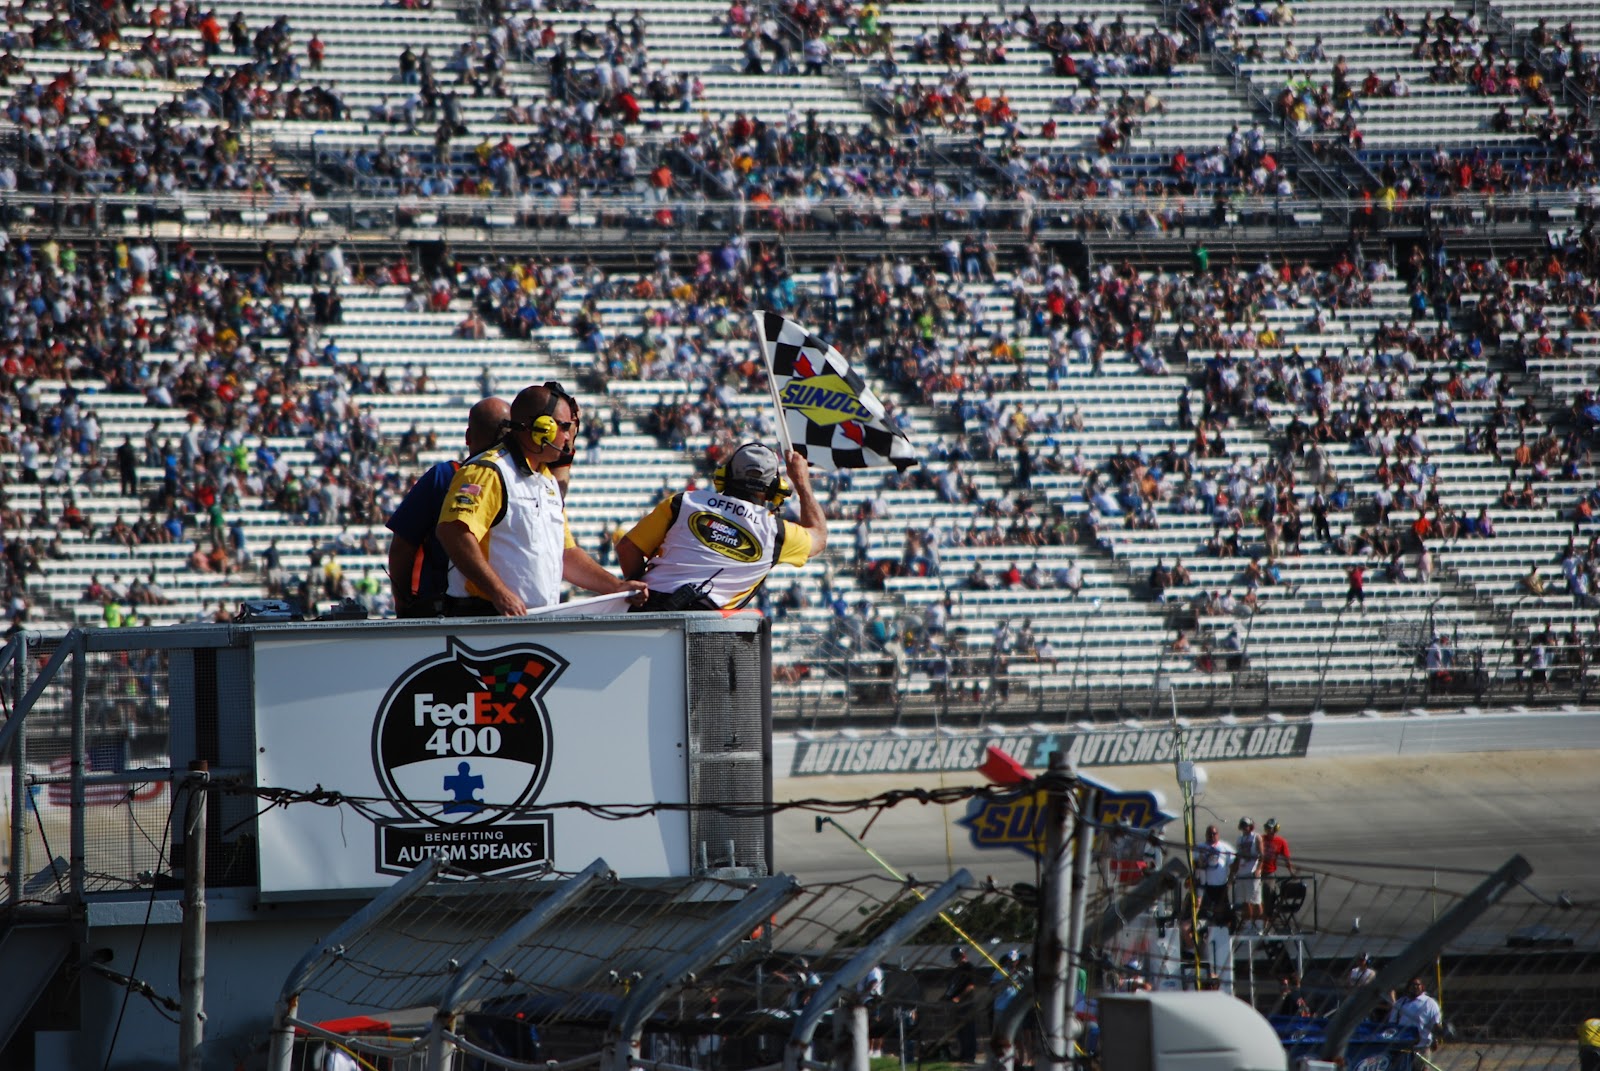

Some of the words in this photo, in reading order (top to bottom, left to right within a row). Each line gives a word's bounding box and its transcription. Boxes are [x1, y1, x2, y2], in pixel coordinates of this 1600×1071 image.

[707, 497, 760, 525] OFFICIAL
[709, 520, 738, 537] NASCAR
[710, 530, 738, 546] Sprint
[414, 691, 518, 727] FedEx
[425, 726, 501, 755] 400
[979, 803, 1147, 838] SUCO
[424, 831, 504, 842] BENEFITING
